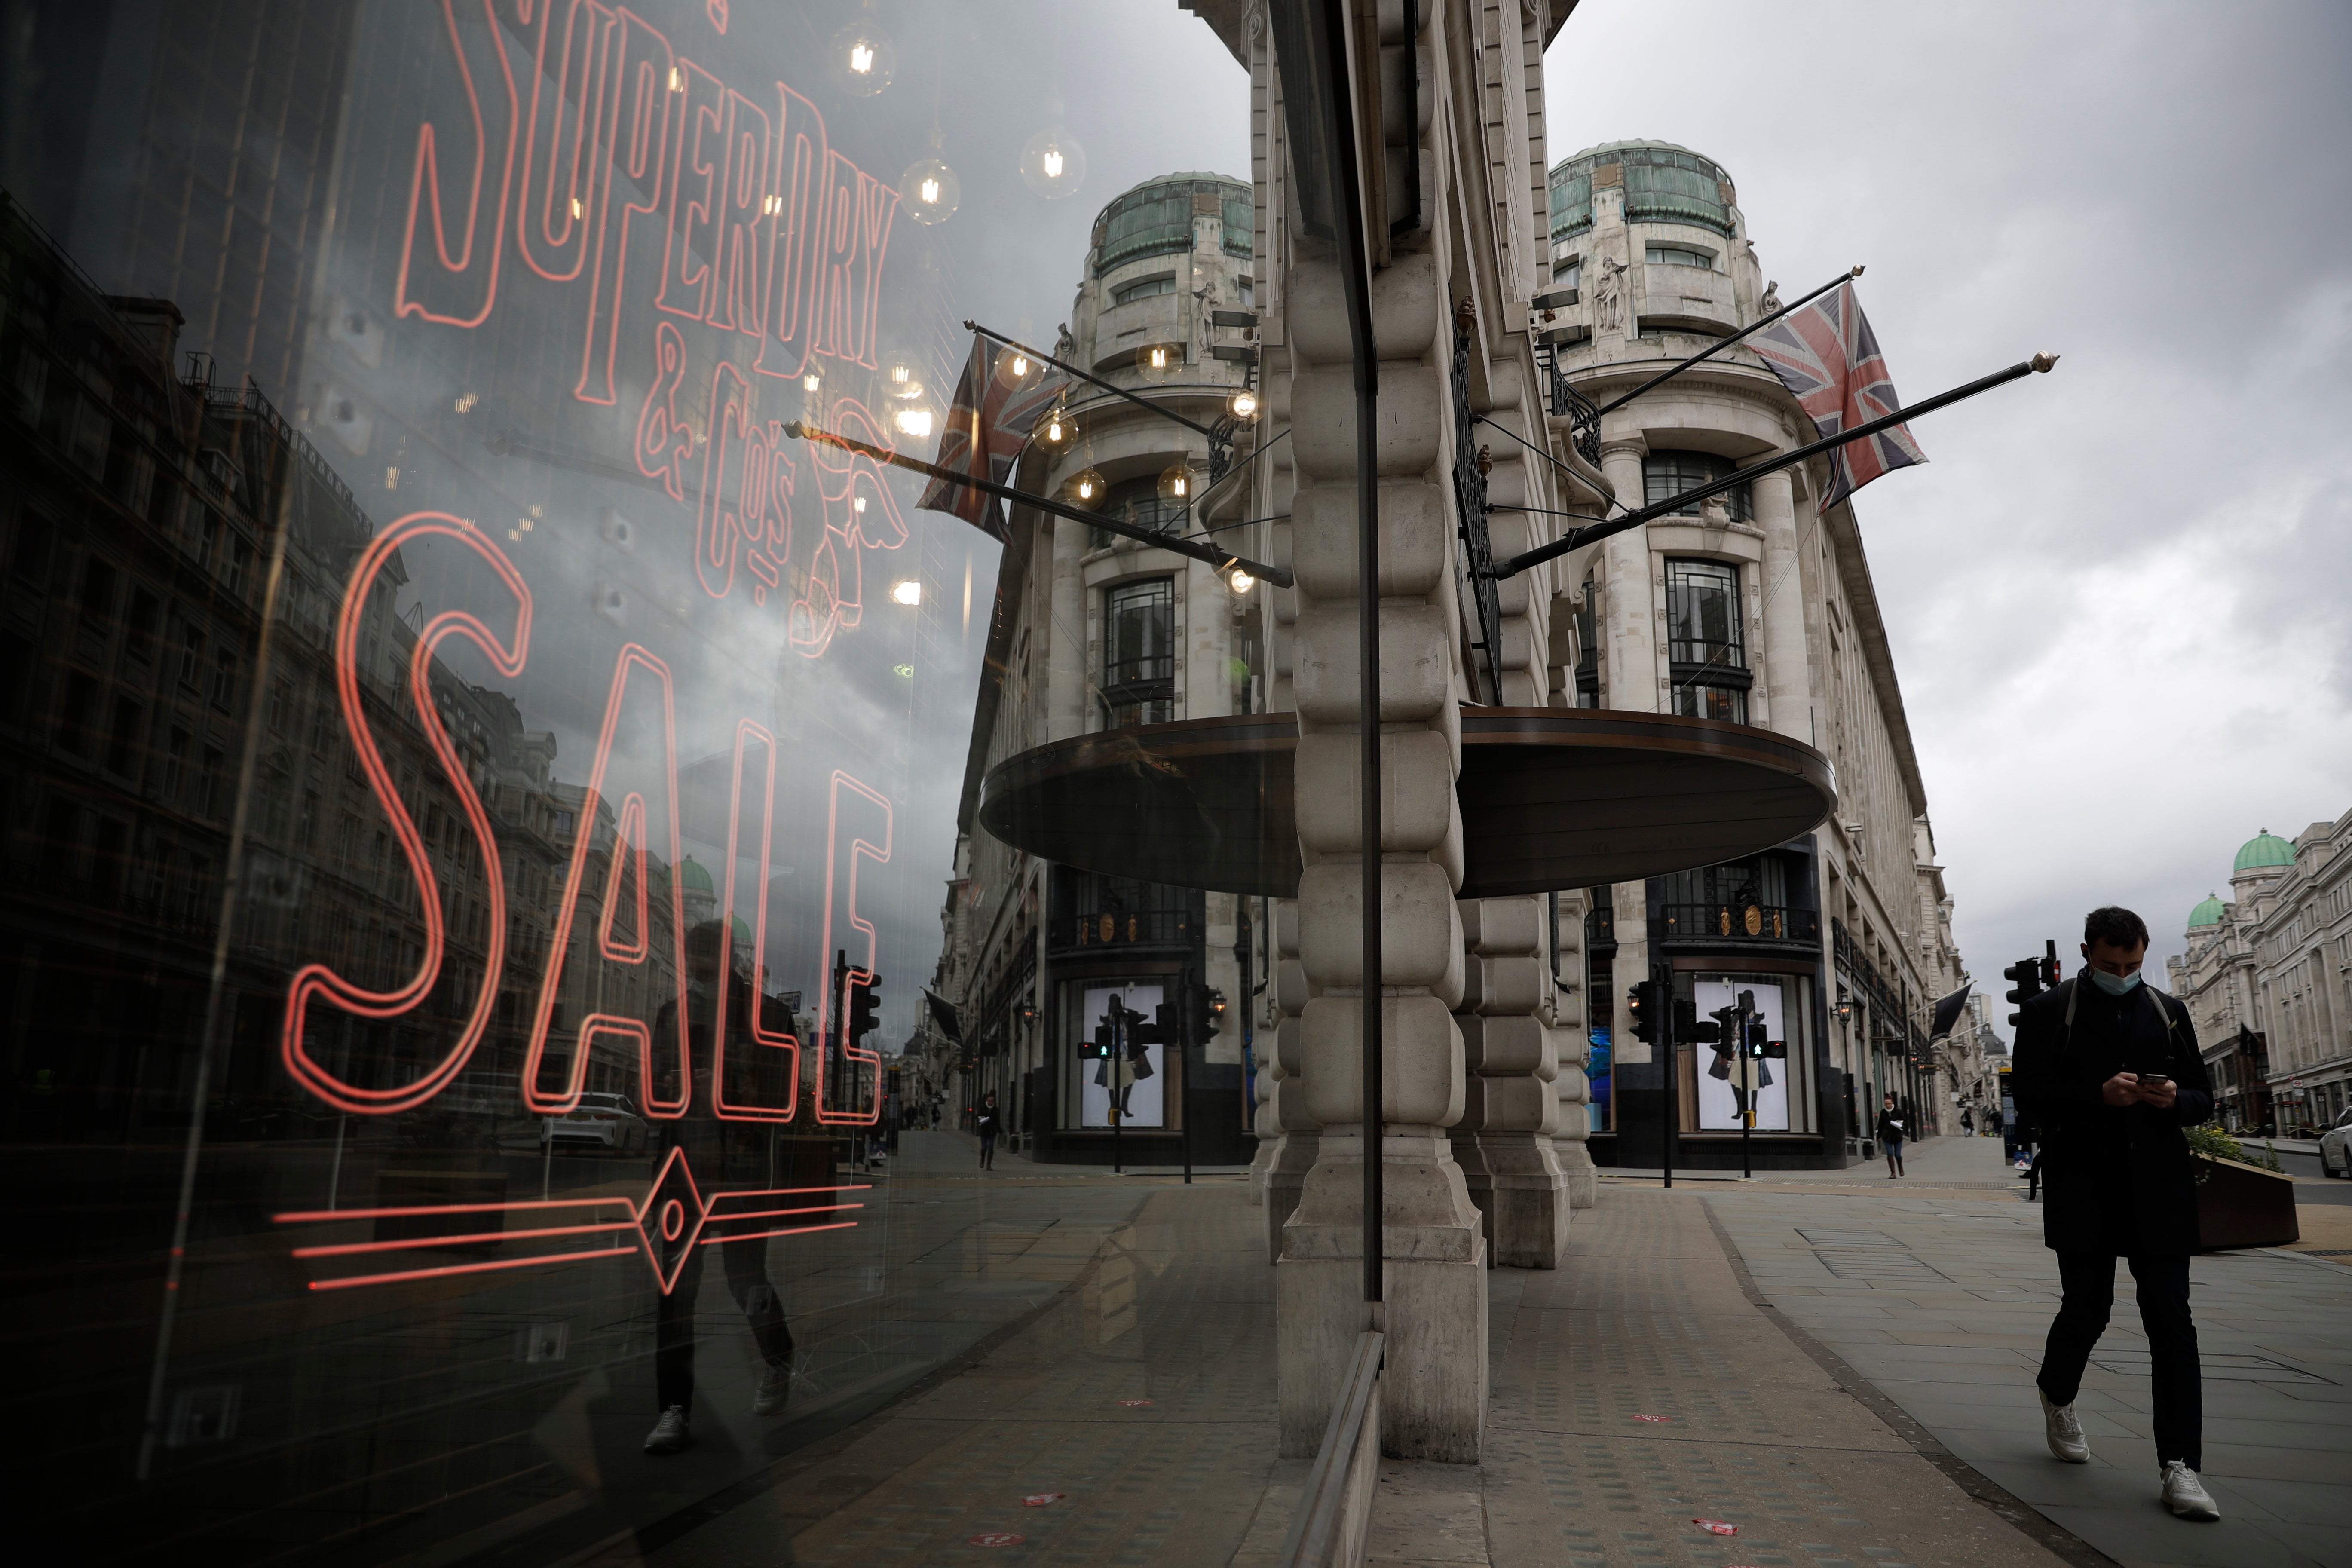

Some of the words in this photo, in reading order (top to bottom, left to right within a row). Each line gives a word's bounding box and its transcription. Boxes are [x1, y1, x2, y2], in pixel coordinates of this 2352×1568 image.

[396, 0, 901, 405] SUPERDRY
[634, 321, 693, 502] &
[282, 511, 893, 1126] SALE
